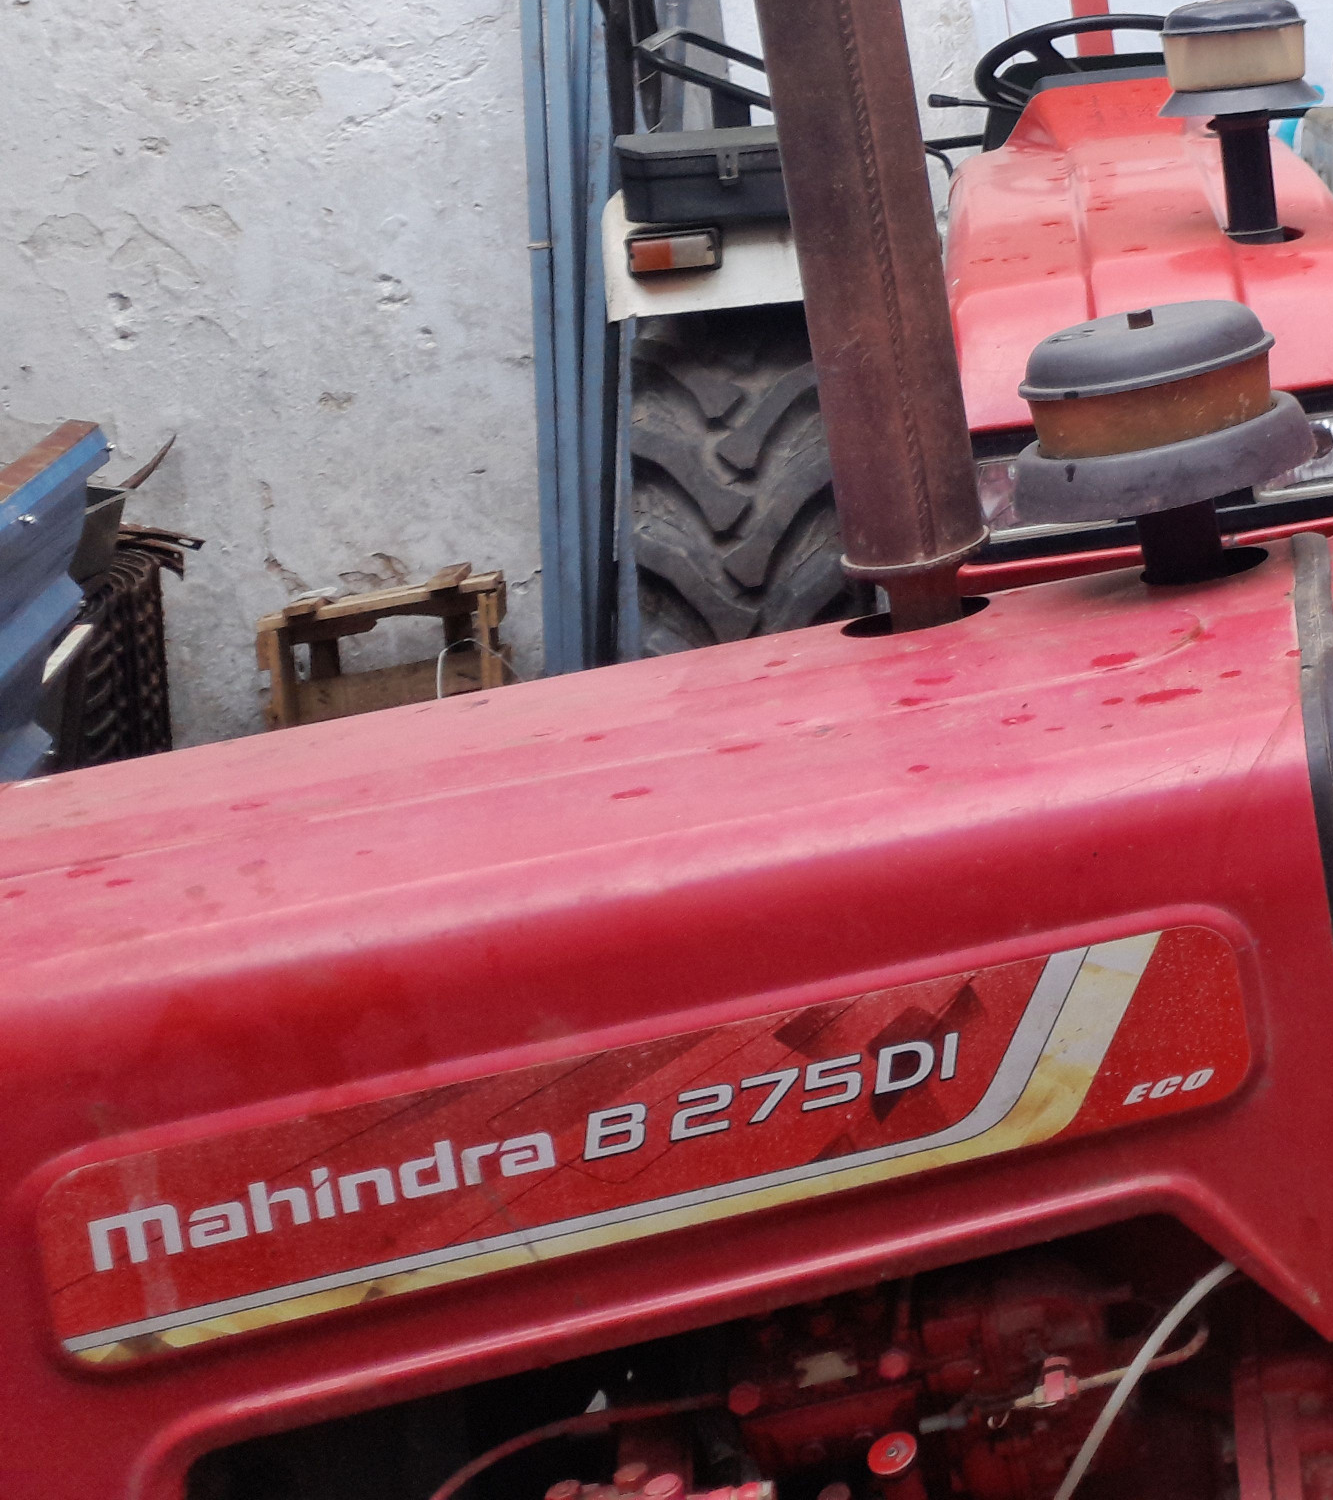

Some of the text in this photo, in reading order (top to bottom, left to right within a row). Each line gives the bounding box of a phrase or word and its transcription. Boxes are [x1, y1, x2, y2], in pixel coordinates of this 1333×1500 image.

[1123, 1067, 1214, 1106] ECO
[87, 1132, 556, 1272] Mahindra
[583, 1103, 647, 1161] B
